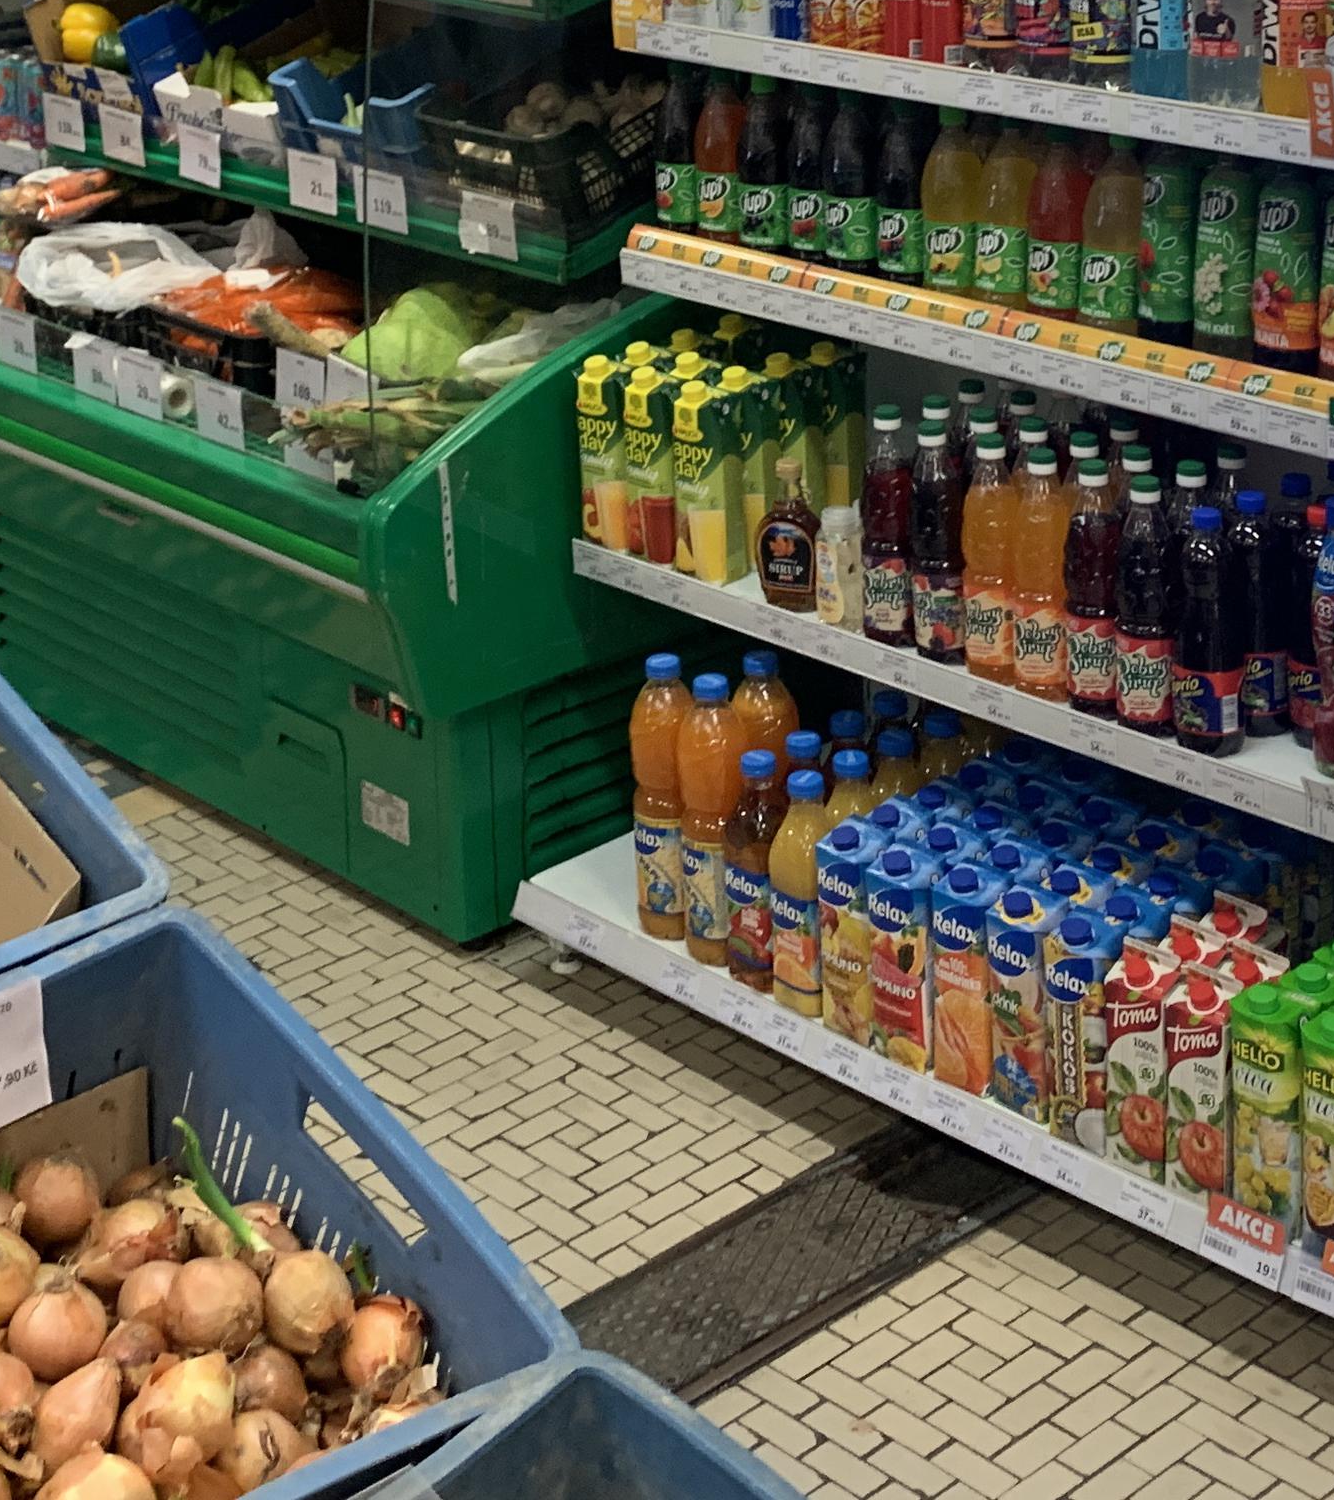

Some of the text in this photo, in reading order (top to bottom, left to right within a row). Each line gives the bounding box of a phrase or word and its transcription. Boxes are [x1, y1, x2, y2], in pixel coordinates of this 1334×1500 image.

[1312, 82, 1333, 147] AKCE
[578, 416, 617, 437] appy
[624, 427, 663, 452] appy
[579, 434, 607, 456] day
[625, 445, 652, 468] day
[673, 441, 713, 466] appy
[674, 460, 703, 483] day
[725, 871, 761, 897] Relax
[818, 871, 857, 901] Relax
[869, 893, 912, 927] Relax
[933, 912, 978, 945] Relax
[987, 936, 1031, 970] Relax
[1046, 964, 1090, 996] Relax
[1107, 1001, 1159, 1028] Toma
[1167, 1025, 1220, 1051] Toma
[1063, 1012, 1077, 1096] KOKOS
[1232, 1041, 1281, 1071] HELLO
[1218, 1204, 1275, 1245] AKCE
